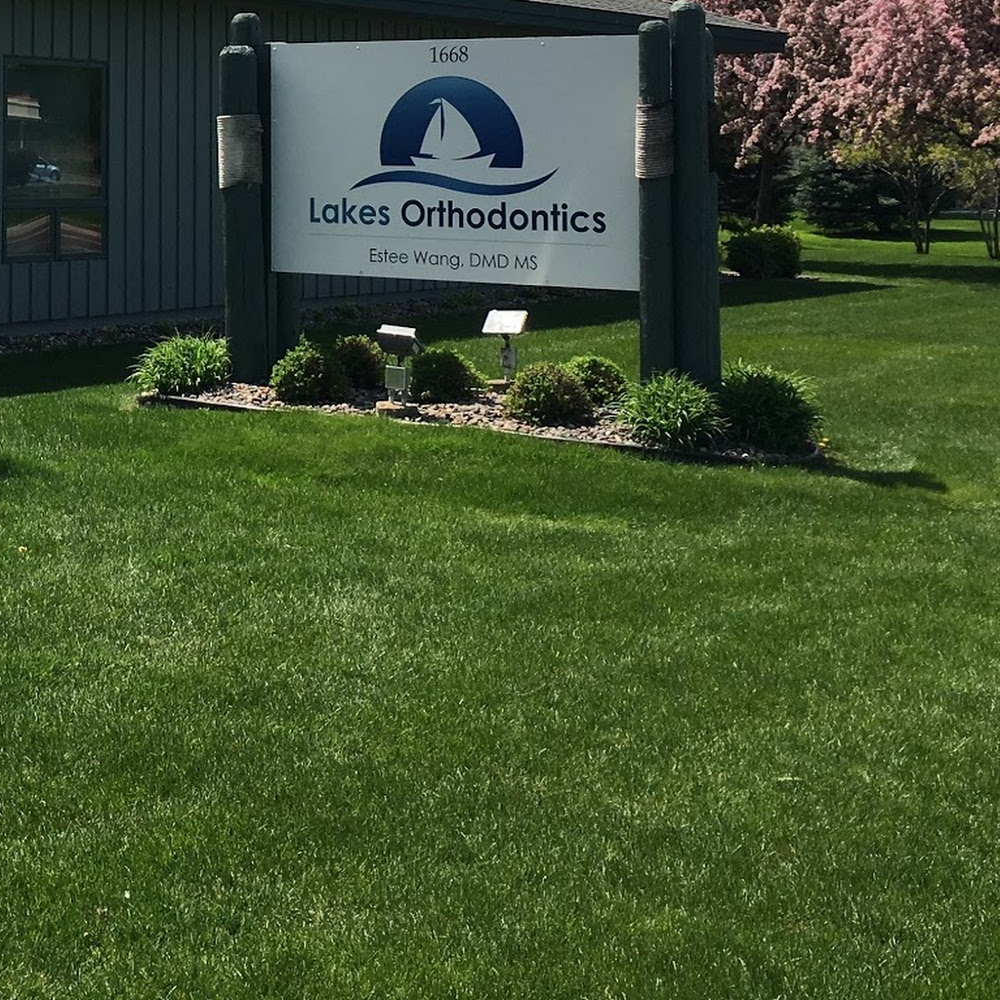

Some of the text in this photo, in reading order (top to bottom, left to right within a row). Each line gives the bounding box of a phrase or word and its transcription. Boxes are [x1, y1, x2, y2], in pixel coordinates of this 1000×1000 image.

[430, 45, 469, 63] 1668
[310, 198, 607, 233] Lakes Orthodontics
[369, 248, 538, 270] Estee Wang, DMD MS
